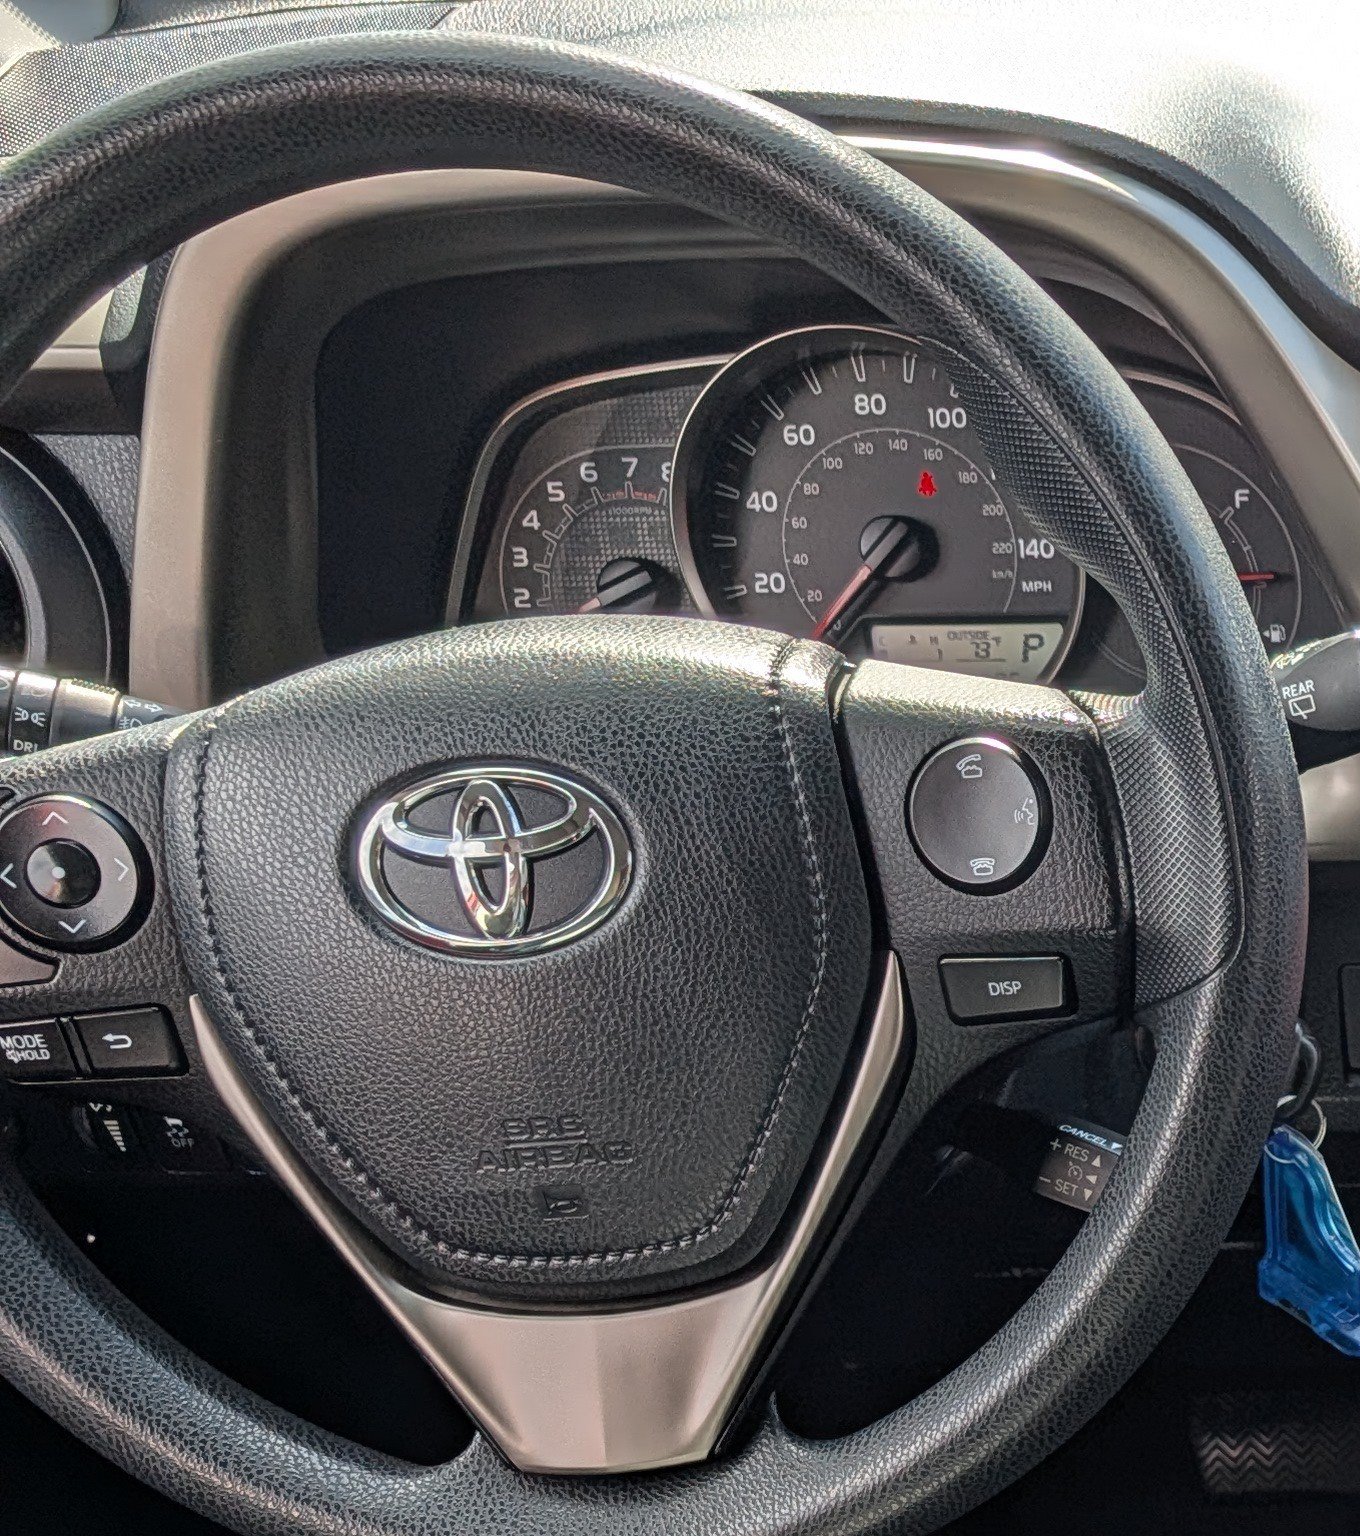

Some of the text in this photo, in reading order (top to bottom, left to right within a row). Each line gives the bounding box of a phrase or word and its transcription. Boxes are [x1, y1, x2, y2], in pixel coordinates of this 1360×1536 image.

[854, 393, 887, 416] 80
[927, 407, 968, 429] 100
[783, 424, 816, 447] 60
[888, 438, 908, 451] 140
[854, 442, 874, 455] 120
[923, 449, 943, 462] 160
[580, 462, 599, 483] 6
[621, 457, 639, 478] 7
[822, 457, 843, 470] 100
[958, 471, 978, 484] 180
[546, 481, 566, 503] 5
[803, 483, 820, 496] 80
[1234, 488, 1250, 509] F
[746, 491, 778, 513] 40
[982, 503, 1004, 517] 200
[522, 510, 542, 531] 4
[791, 517, 808, 530] 60
[512, 546, 530, 568] 3
[992, 542, 1013, 555] 220
[1018, 538, 1055, 560] 140
[792, 553, 809, 566] 40
[754, 573, 786, 594] 20
[1021, 579, 1053, 593] MPH
[513, 588, 532, 609] 2
[807, 590, 823, 603] 20
[1022, 633, 1045, 663] P
[1282, 679, 1315, 699] REAR
[987, 982, 1022, 997] DISP
[0, 1033, 48, 1050] MODE
[16, 1049, 51, 1061] HOLD
[171, 1138, 195, 1149] OFF
[1059, 1124, 1107, 1147] CANCEL
[1064, 1143, 1090, 1162] RES
[1054, 1178, 1079, 1197] SET
